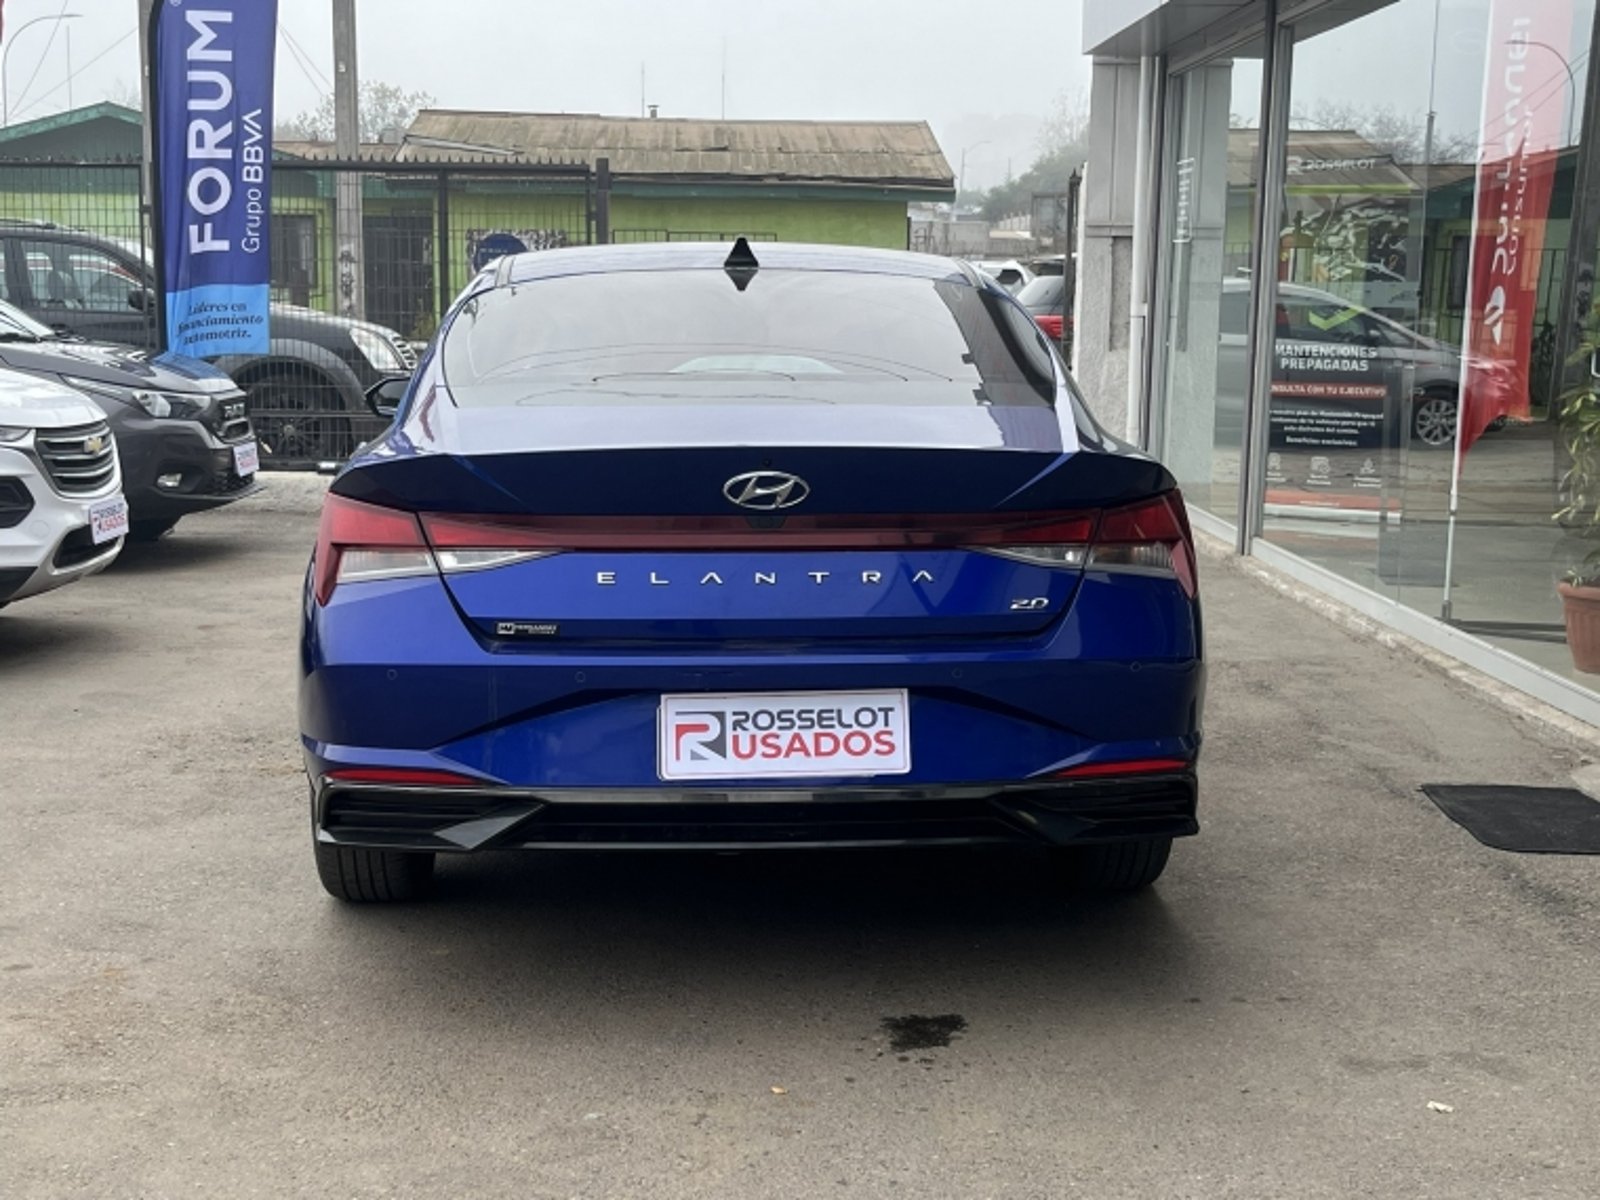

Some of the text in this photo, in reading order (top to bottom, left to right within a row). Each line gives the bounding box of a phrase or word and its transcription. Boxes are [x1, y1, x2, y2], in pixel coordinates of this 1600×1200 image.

[185, 9, 234, 255] FORUM
[242, 108, 265, 254] Grupo BBVA
[1275, 344, 1378, 359] MANTENCIONES
[1281, 358, 1369, 371] PREPAGADAS
[1270, 384, 1305, 394] NSULTA
[597, 571, 934, 586] ELANTRA
[731, 707, 896, 732] ROSSELOT
[731, 730, 896, 760] USADOS
